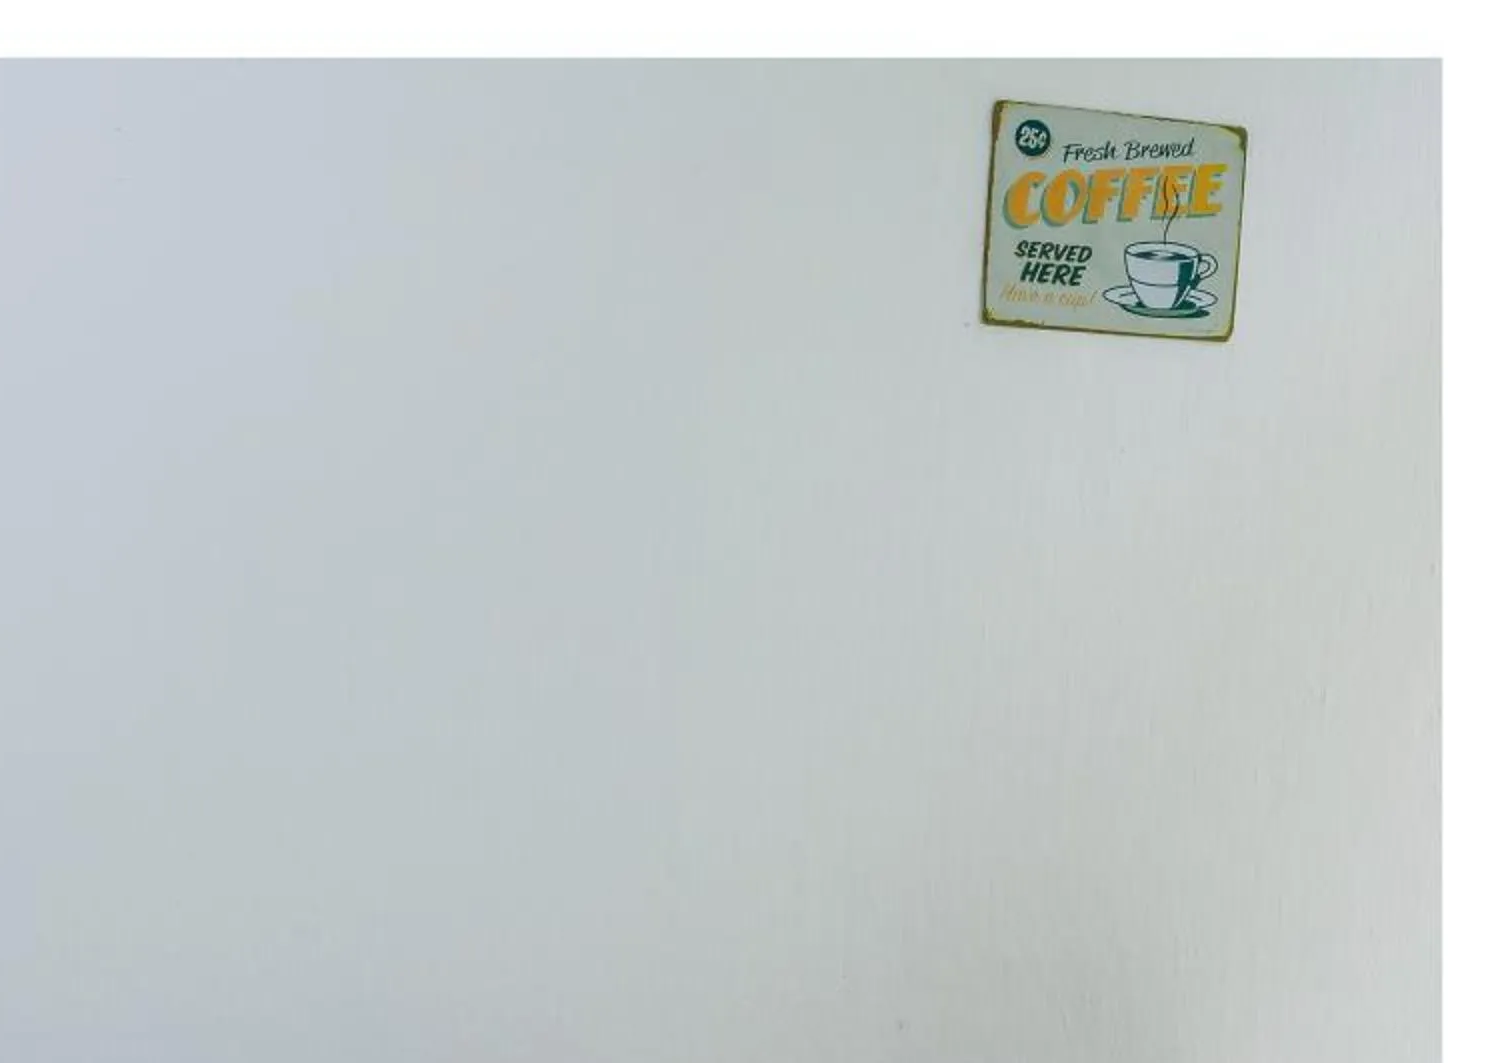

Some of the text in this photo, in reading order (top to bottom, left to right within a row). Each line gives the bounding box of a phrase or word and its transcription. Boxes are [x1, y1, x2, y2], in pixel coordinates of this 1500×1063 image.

[1063, 137, 1196, 163] Fresh Brewed
[1003, 163, 1228, 229] COFFEE
[1014, 240, 1093, 263] SERVED
[1019, 262, 1087, 287] HERE
